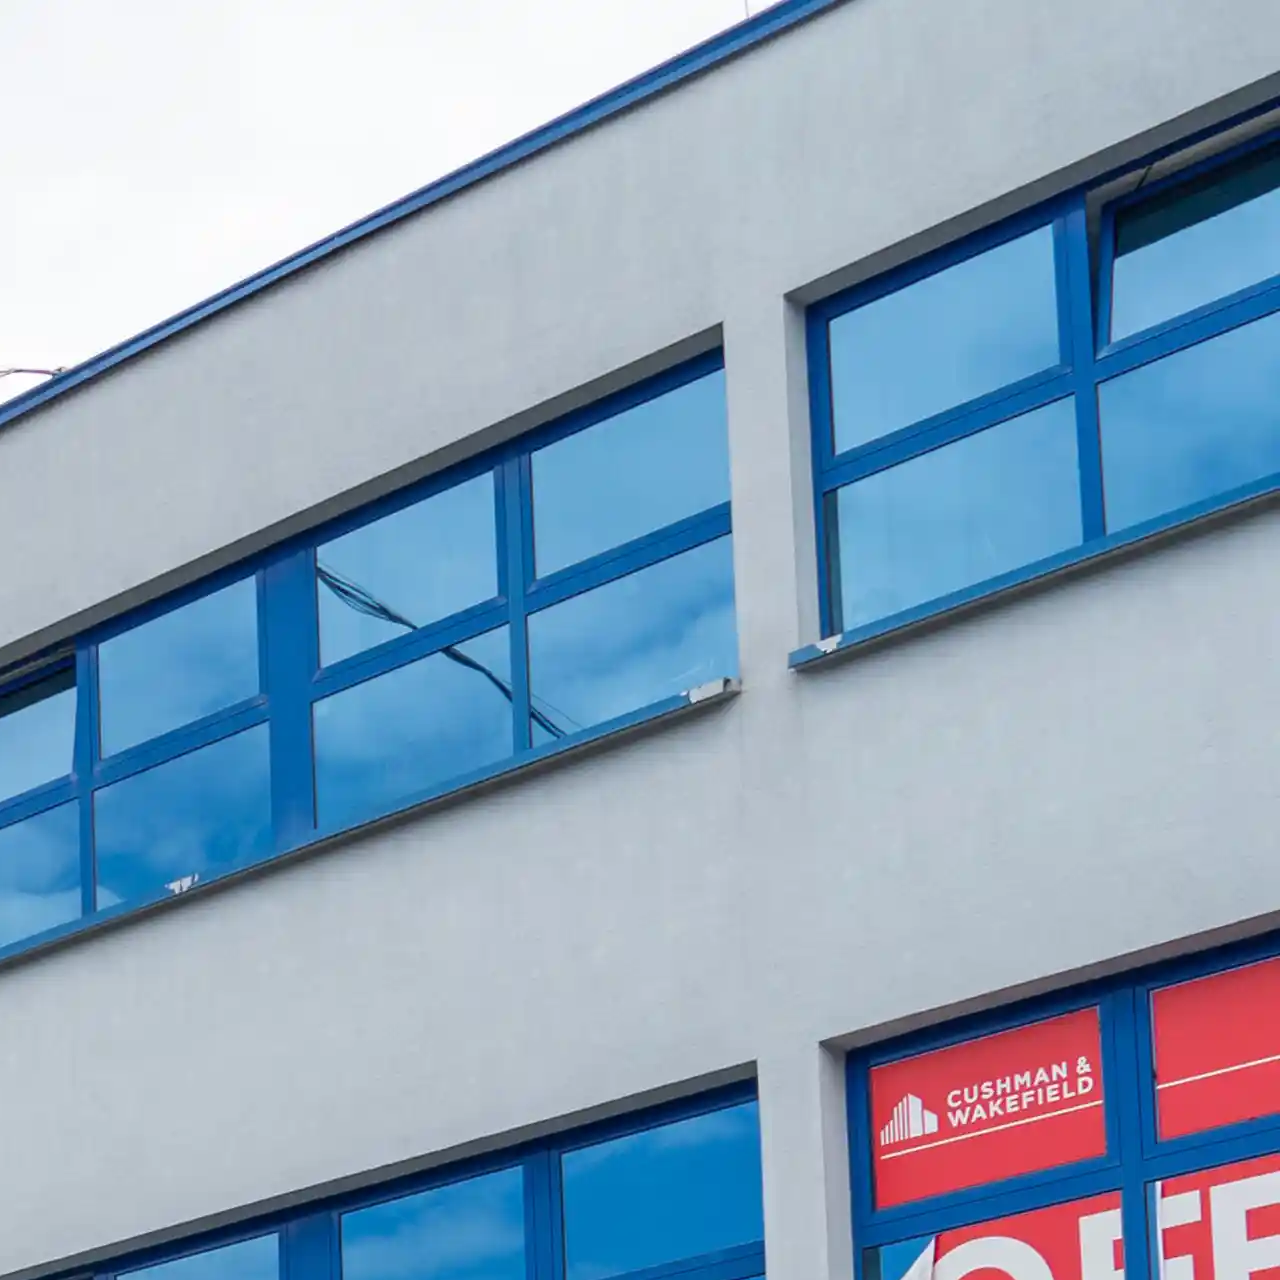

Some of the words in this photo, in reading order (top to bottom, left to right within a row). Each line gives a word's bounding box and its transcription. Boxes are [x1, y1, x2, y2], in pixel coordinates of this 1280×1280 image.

[947, 1062, 1068, 1108] CUSHMAN
[1076, 1056, 1092, 1075] &
[947, 1075, 1093, 1127] WAKEFIELD
